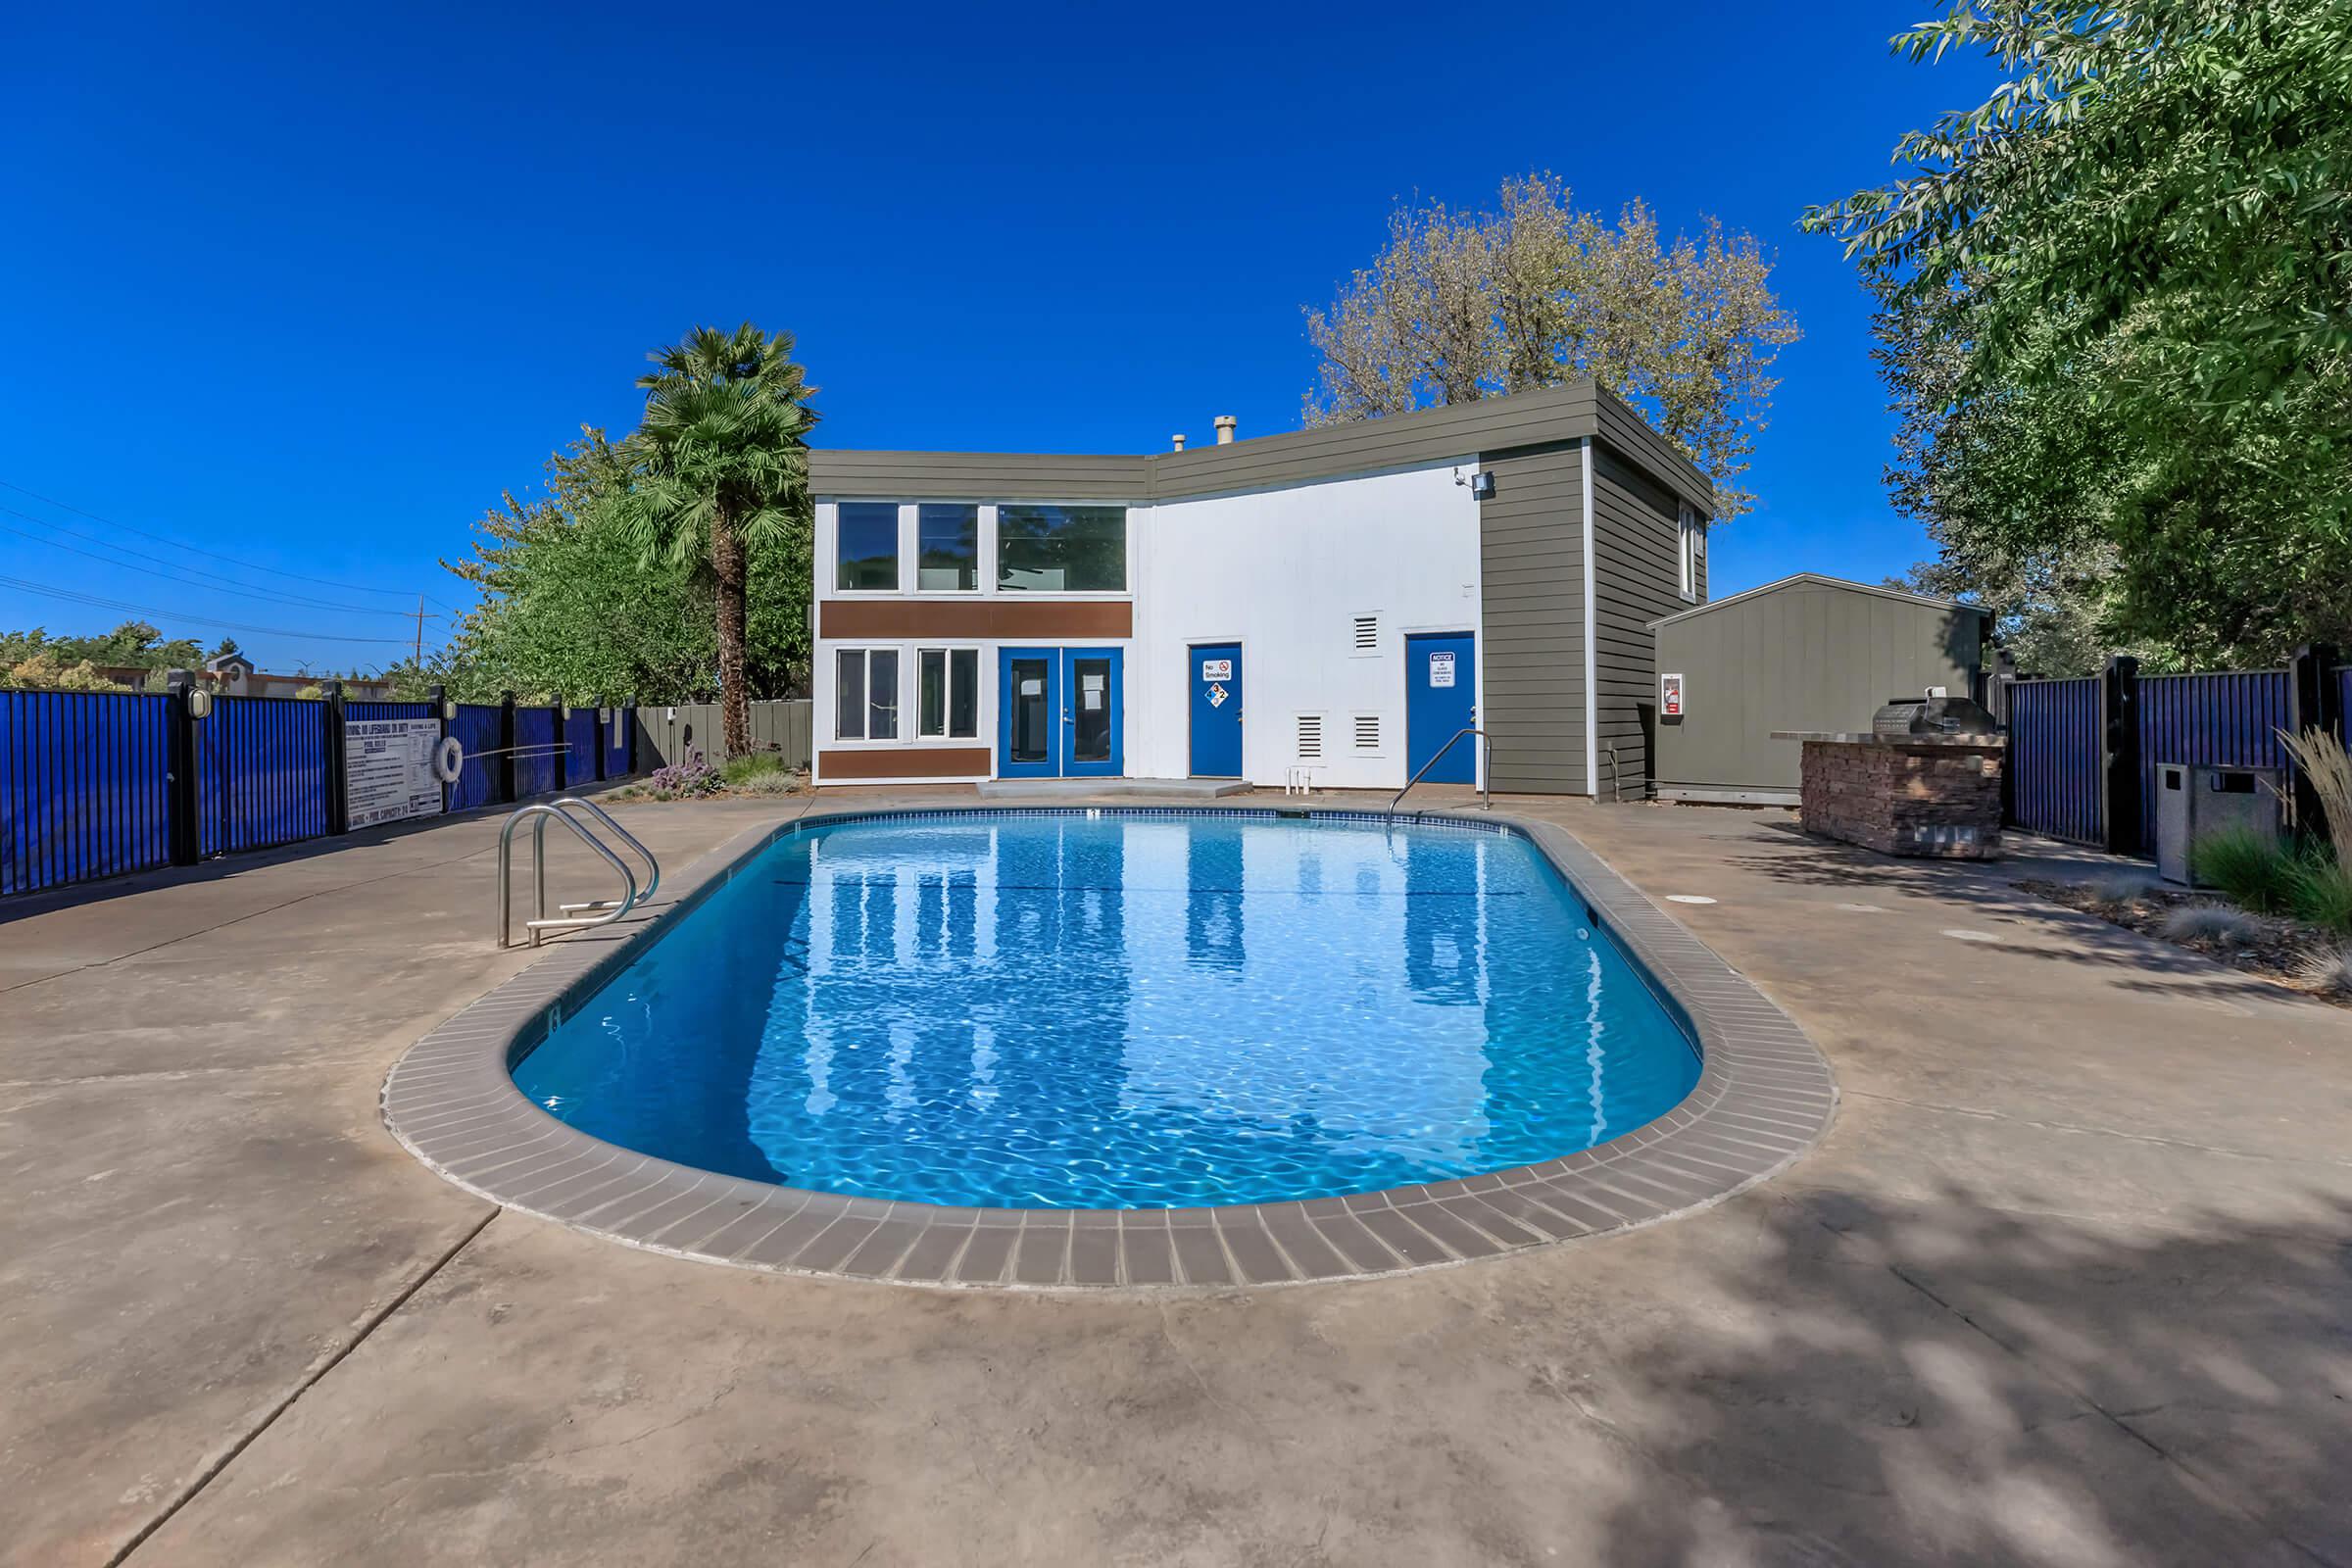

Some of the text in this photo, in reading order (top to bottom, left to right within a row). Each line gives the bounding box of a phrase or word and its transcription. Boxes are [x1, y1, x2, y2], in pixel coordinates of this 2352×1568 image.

[368, 724, 391, 734] LIFEGUARD
[392, 723, 397, 733] ON
[398, 722, 408, 733] DUTY
